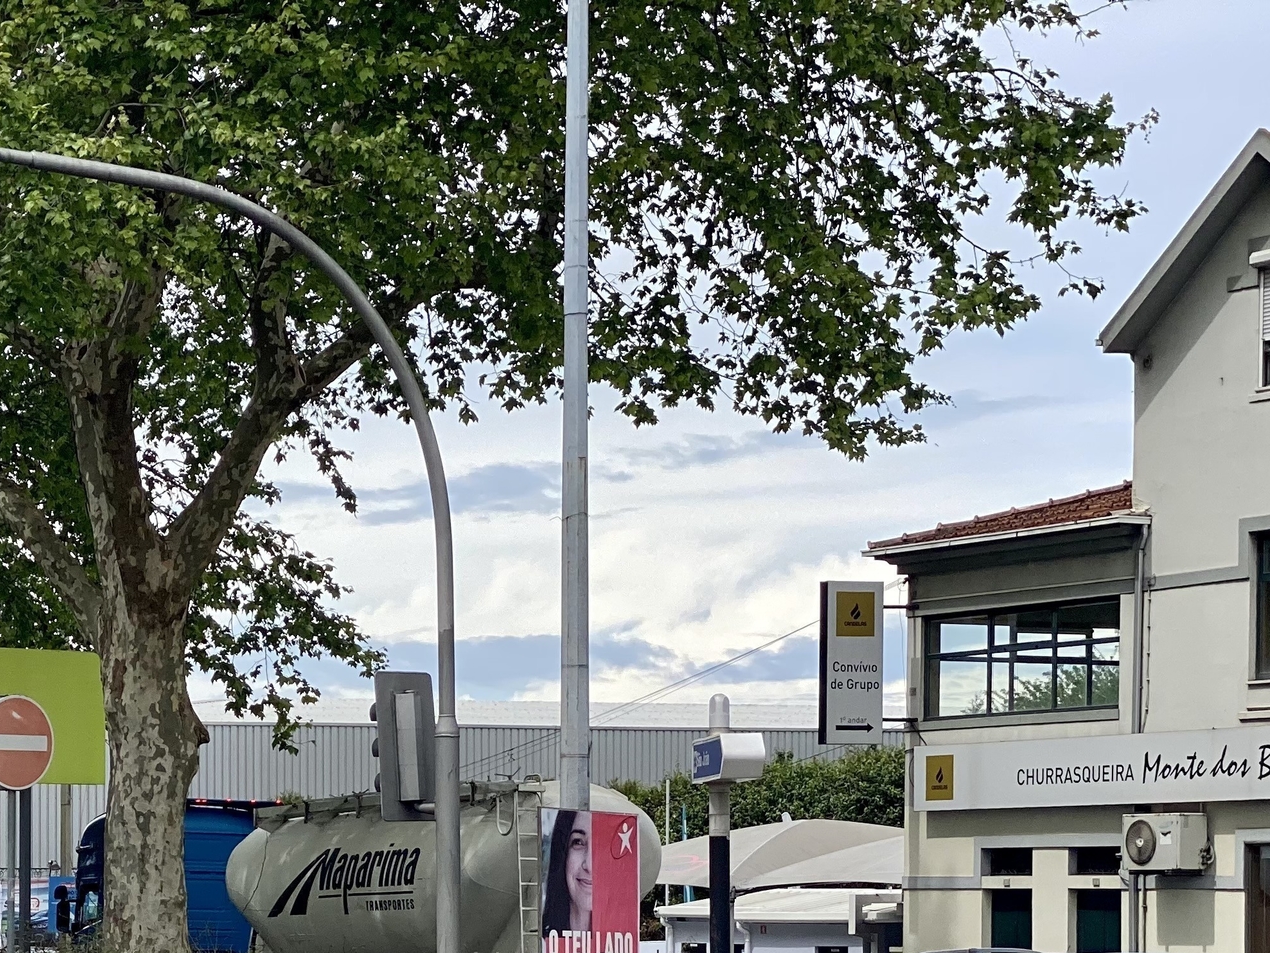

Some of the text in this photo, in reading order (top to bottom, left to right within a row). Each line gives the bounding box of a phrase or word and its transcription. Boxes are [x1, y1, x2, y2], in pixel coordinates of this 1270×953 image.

[830, 678, 880, 693] de Grupo
[1016, 764, 1135, 786] CHURRASQUEIRA
[1142, 751, 1207, 784] Monte
[1209, 744, 1252, 778] dos
[268, 843, 421, 917] Maparima
[366, 899, 415, 911] TRANSPORTES
